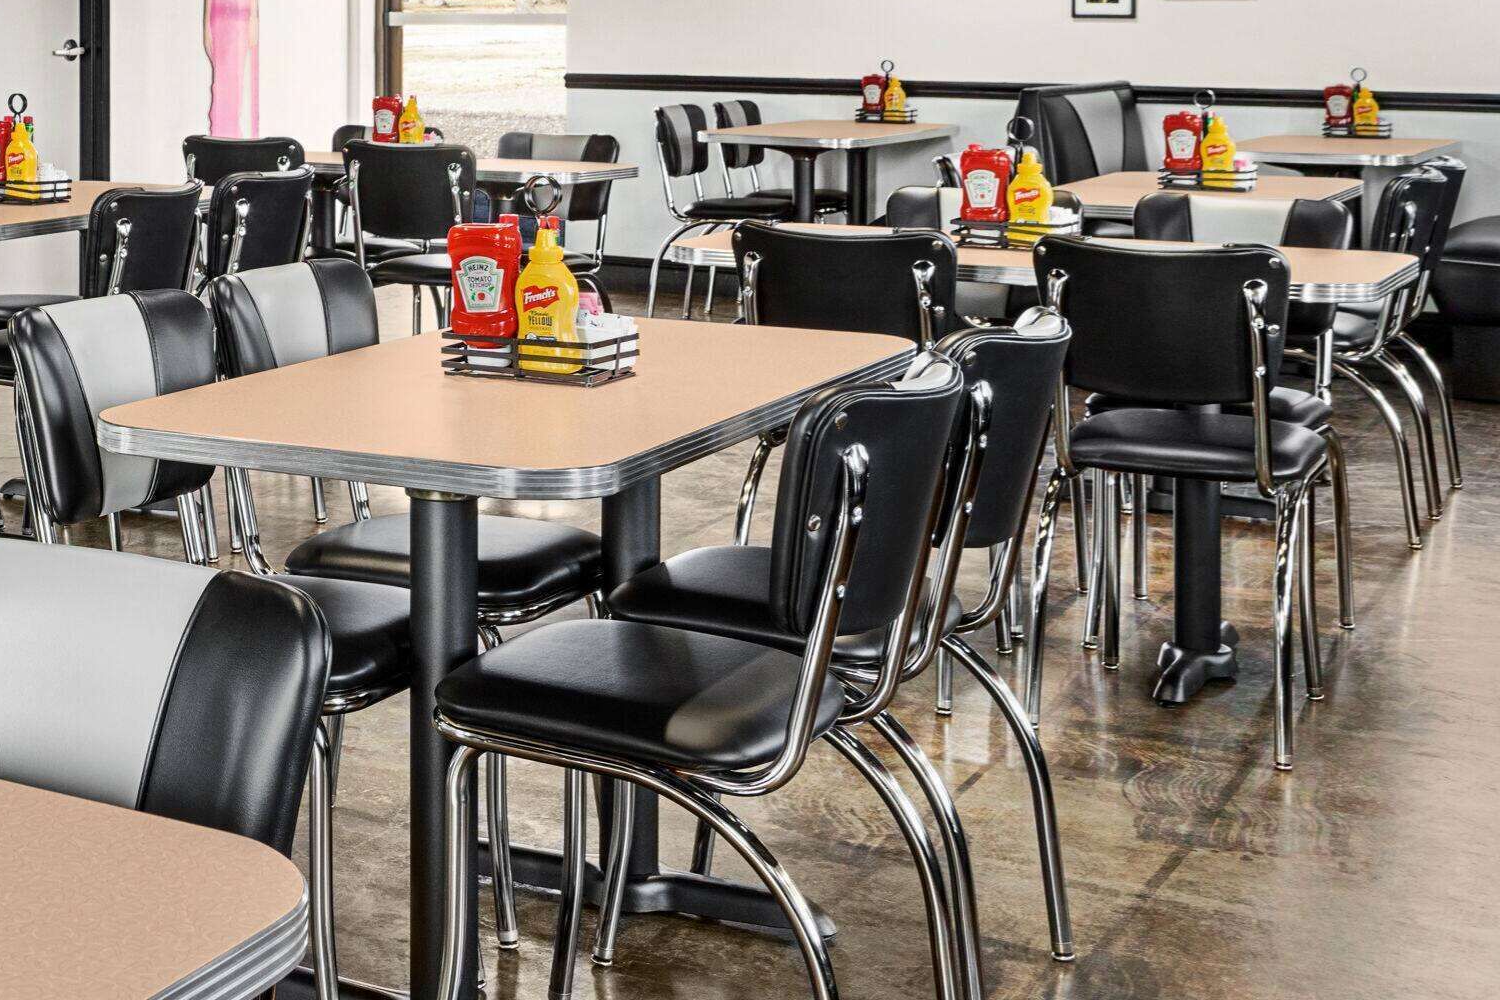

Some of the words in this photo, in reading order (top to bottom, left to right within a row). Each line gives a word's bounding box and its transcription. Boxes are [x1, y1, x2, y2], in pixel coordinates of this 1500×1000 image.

[468, 264, 489, 272] HEINZ
[467, 275, 492, 283] TOMATO
[524, 288, 556, 305] French's
